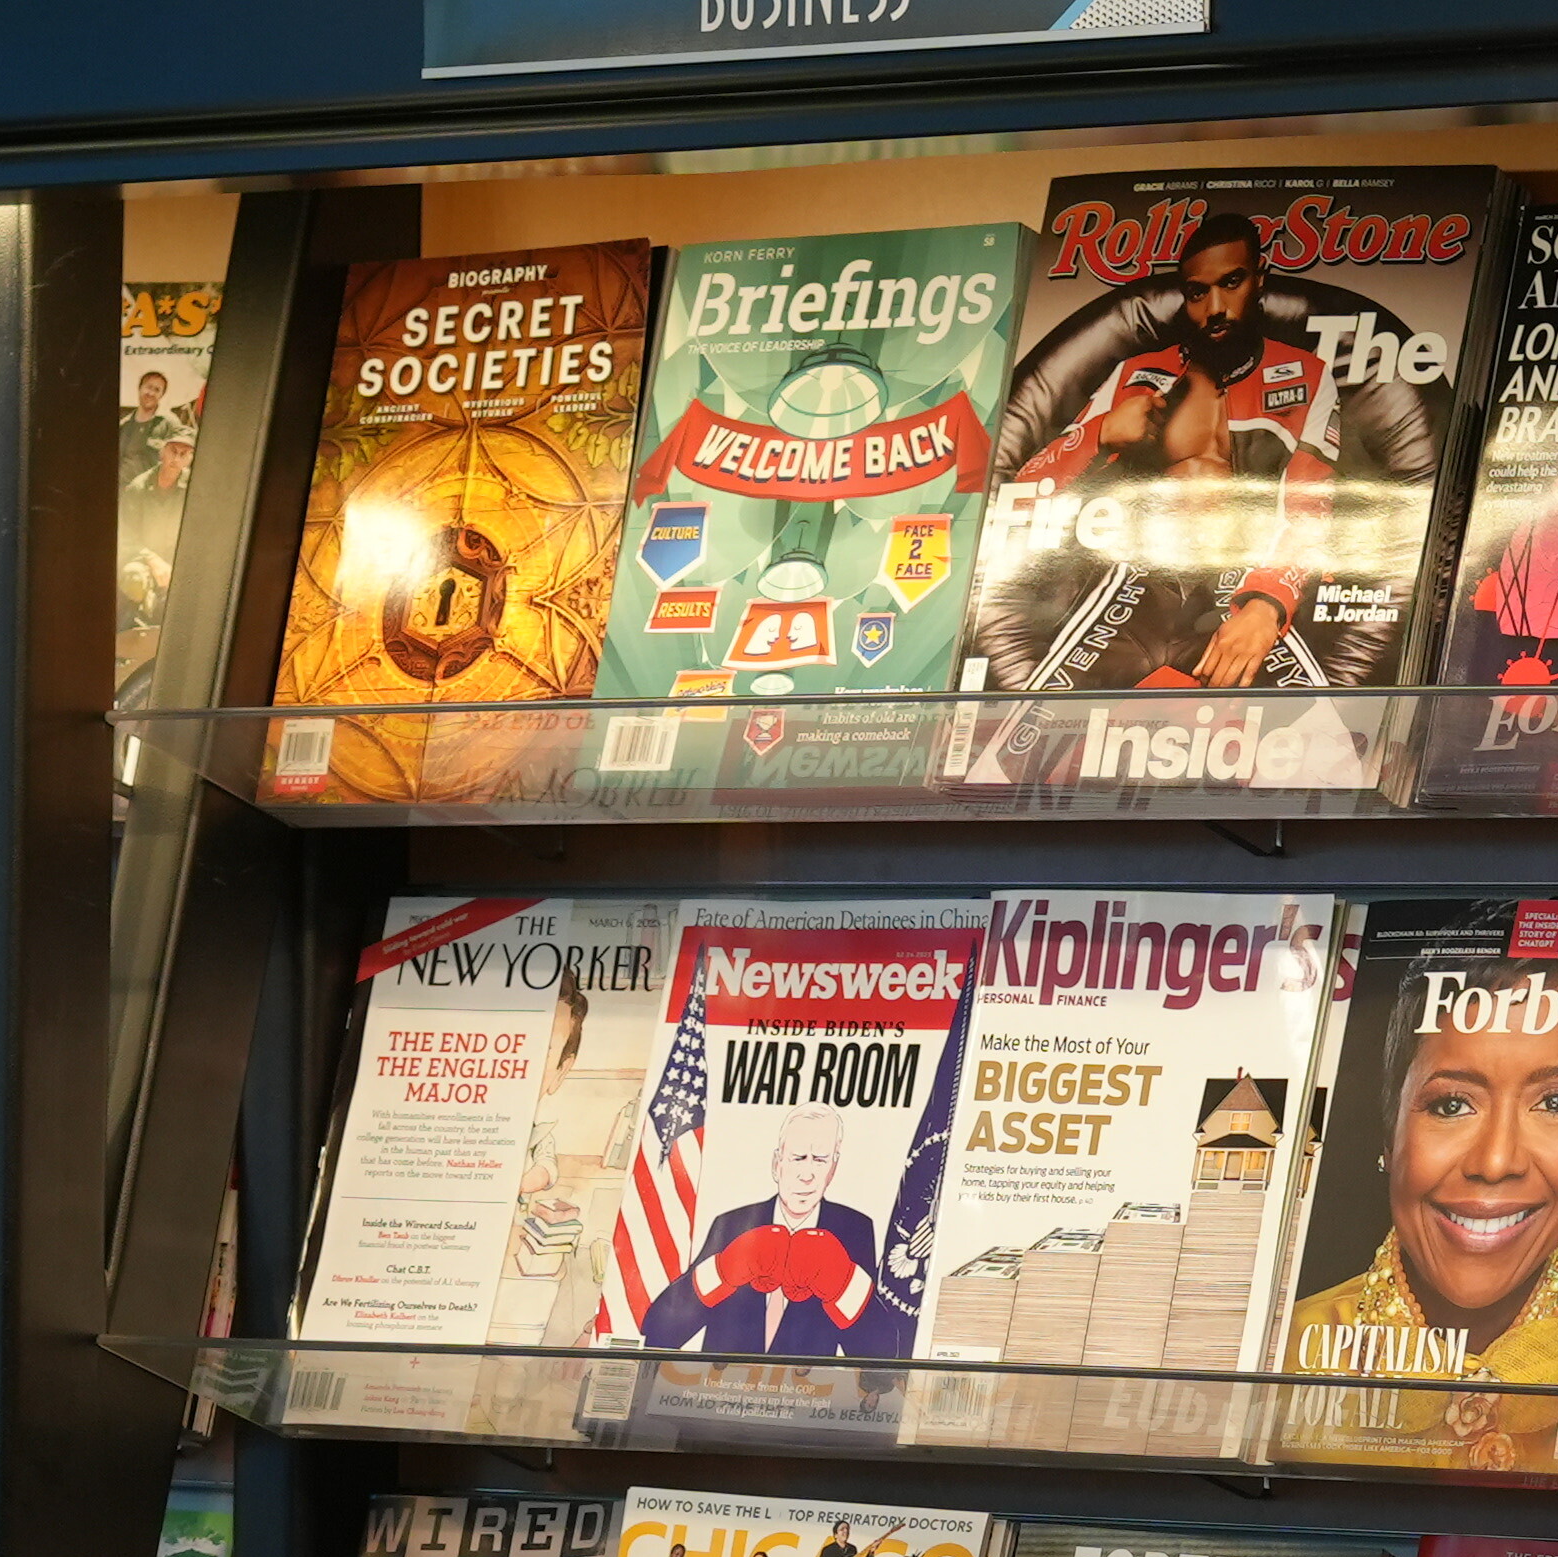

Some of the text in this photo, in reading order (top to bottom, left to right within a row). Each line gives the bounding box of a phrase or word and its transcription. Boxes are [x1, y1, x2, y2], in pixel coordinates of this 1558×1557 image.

[703, 247, 795, 264] KORN FERRY
[686, 259, 993, 342] Briefings
[402, 295, 579, 345] SECRET
[710, 342, 741, 353] VOICE
[742, 342, 758, 352] OF
[759, 339, 825, 352] LEADERSHIP
[358, 342, 613, 396] SOCIETIES
[1316, 583, 1391, 603] Michael
[1313, 603, 1398, 623] B. Jordan
[398, 942, 654, 992] NEW YORKER
[983, 900, 1323, 1011] Kiplinger's
[705, 947, 965, 1000] Newsweek
[1056, 994, 1107, 1007] FINANCE
[747, 1019, 904, 1038] INSIDE BIDEN'S
[388, 1030, 527, 1055] THE END OF
[980, 1034, 1150, 1055] Make the Most of Your
[377, 1056, 528, 1079] THE ENGLISH
[723, 1042, 919, 1108] WAR ROOM
[404, 1082, 487, 1104] MAJOR
[974, 1060, 1163, 1107] BIGGEST
[965, 1110, 1112, 1155] ASSET
[788, 1509, 973, 1532] TOP RESPIRATORY DOCTORS
